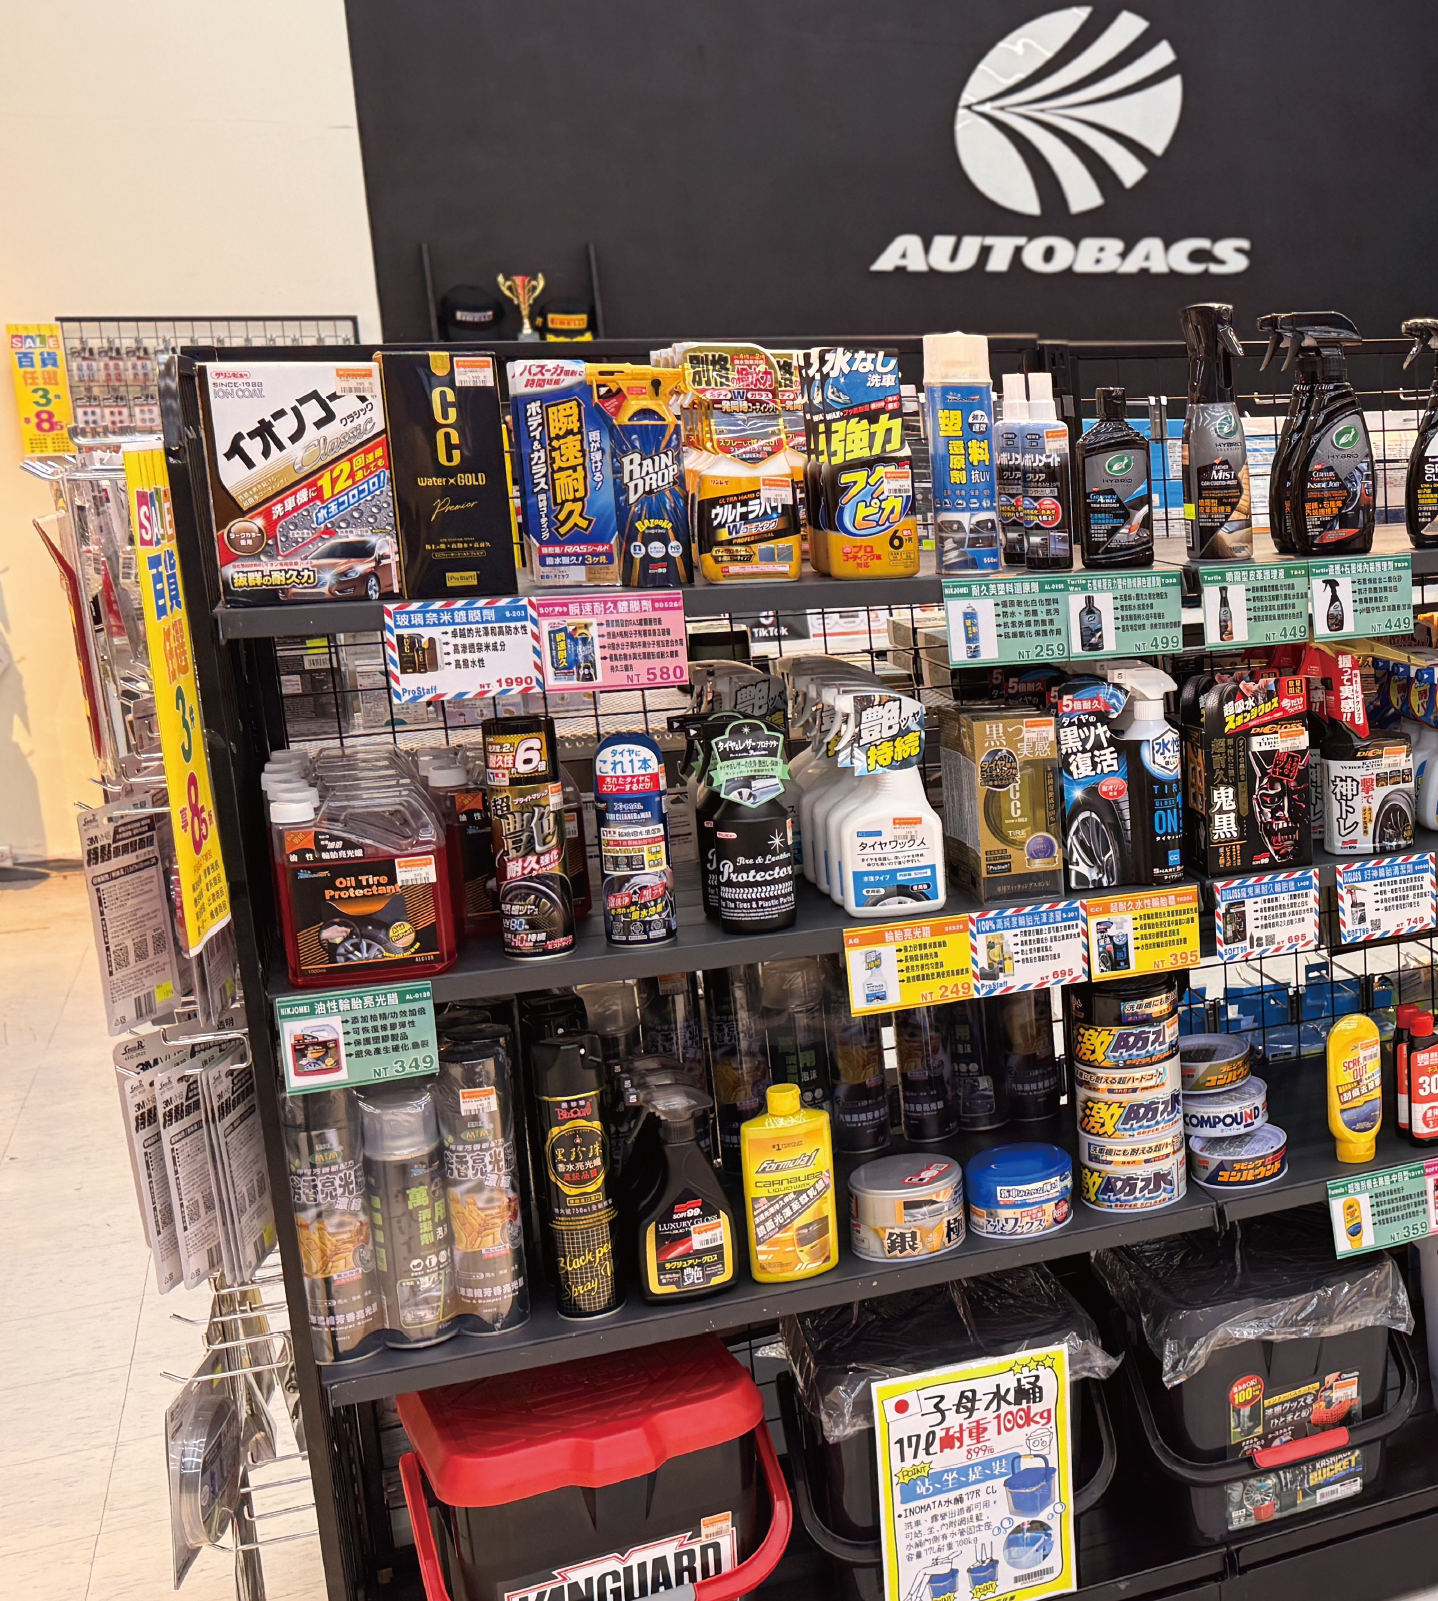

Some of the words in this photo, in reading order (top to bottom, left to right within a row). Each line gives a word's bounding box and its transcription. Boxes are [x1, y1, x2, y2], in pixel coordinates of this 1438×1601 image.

[869, 234, 1251, 275] AUTOBACS
[11, 334, 59, 350] SALE
[822, 349, 898, 375] 水なし
[866, 374, 897, 388] 洗車
[829, 412, 904, 466] 強力
[621, 451, 674, 484] RAIN
[626, 462, 678, 505] DROP
[135, 487, 174, 547] SALE
[395, 611, 496, 627] 玻璃奈米鍍膜劑
[1371, 624, 1382, 633] NT
[1384, 616, 1412, 631] 449
[1265, 632, 1276, 641] NT
[1279, 625, 1308, 639] 449
[1018, 650, 1031, 660] NT
[1034, 642, 1067, 658] 259
[1134, 643, 1148, 652] NT
[1150, 635, 1180, 650] 499
[496, 675, 533, 688] 1990
[626, 674, 641, 683] NT
[646, 665, 685, 683] 580
[1061, 694, 1102, 712] 5倍耐久
[1061, 713, 1097, 726] タイヤの
[866, 732, 921, 771] 持続
[1068, 750, 1120, 780] 復活
[719, 858, 793, 885] Protector
[335, 876, 356, 889] Oil
[358, 874, 388, 886] Tire
[1406, 916, 1425, 927] 749
[1287, 933, 1307, 944] 695
[1153, 959, 1166, 969] NT
[1169, 950, 1199, 967] 395
[1052, 968, 1075, 980] 695
[921, 990, 935, 1002] NT
[939, 981, 971, 998] 249
[372, 1066, 389, 1079] NT
[392, 1054, 435, 1076] 349
[1183, 1107, 1261, 1128] COMPOUND
[755, 1170, 823, 1189] CARNAUBA
[658, 1219, 692, 1233] LUXURY
[693, 1214, 719, 1226] GLOSS
[1390, 1232, 1401, 1243] NT
[1402, 1221, 1429, 1240] 359
[920, 1374, 1045, 1428] 子母水桶
[1309, 1455, 1358, 1487] BUCKET
